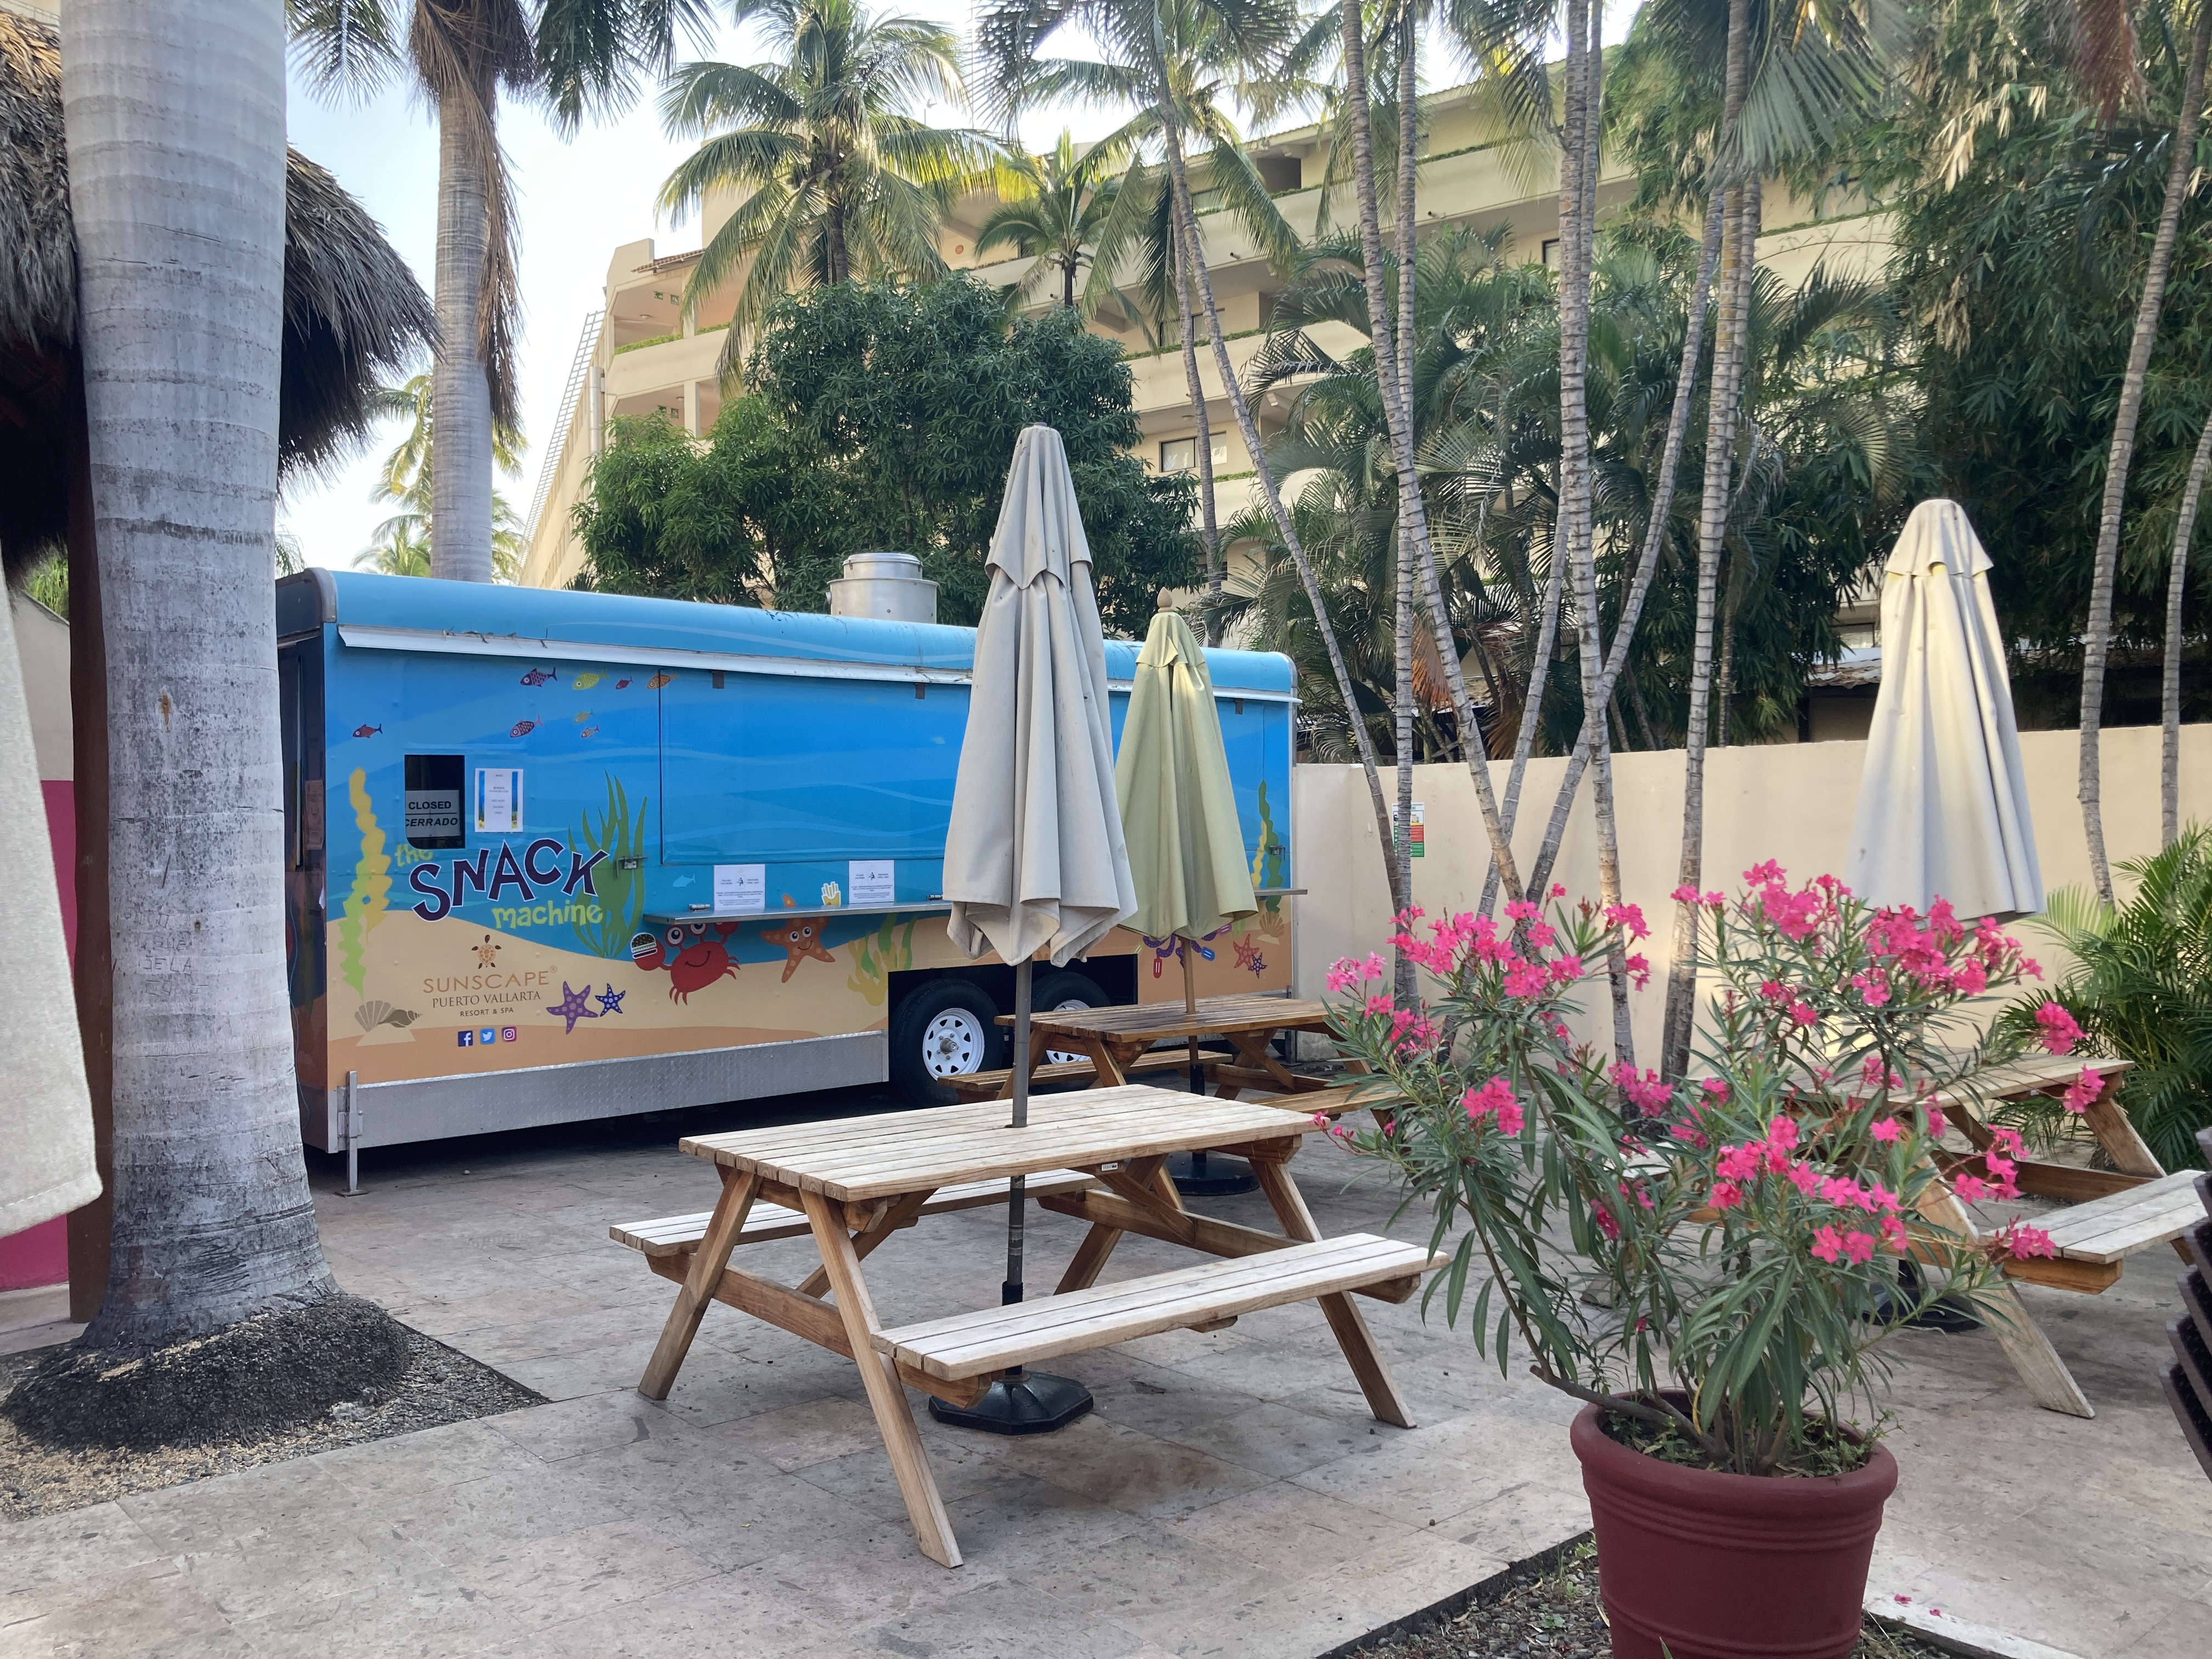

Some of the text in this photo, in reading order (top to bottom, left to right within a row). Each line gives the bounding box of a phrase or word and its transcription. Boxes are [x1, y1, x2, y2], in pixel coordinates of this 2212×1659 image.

[408, 801, 452, 810] CLOSED
[405, 817, 458, 827] CERRADO
[394, 844, 433, 867] the
[409, 838, 610, 922] SNACK
[492, 899, 603, 929] machine
[432, 991, 541, 1008] PUERTO VALLARTA
[460, 1008, 490, 1017] RESORT
